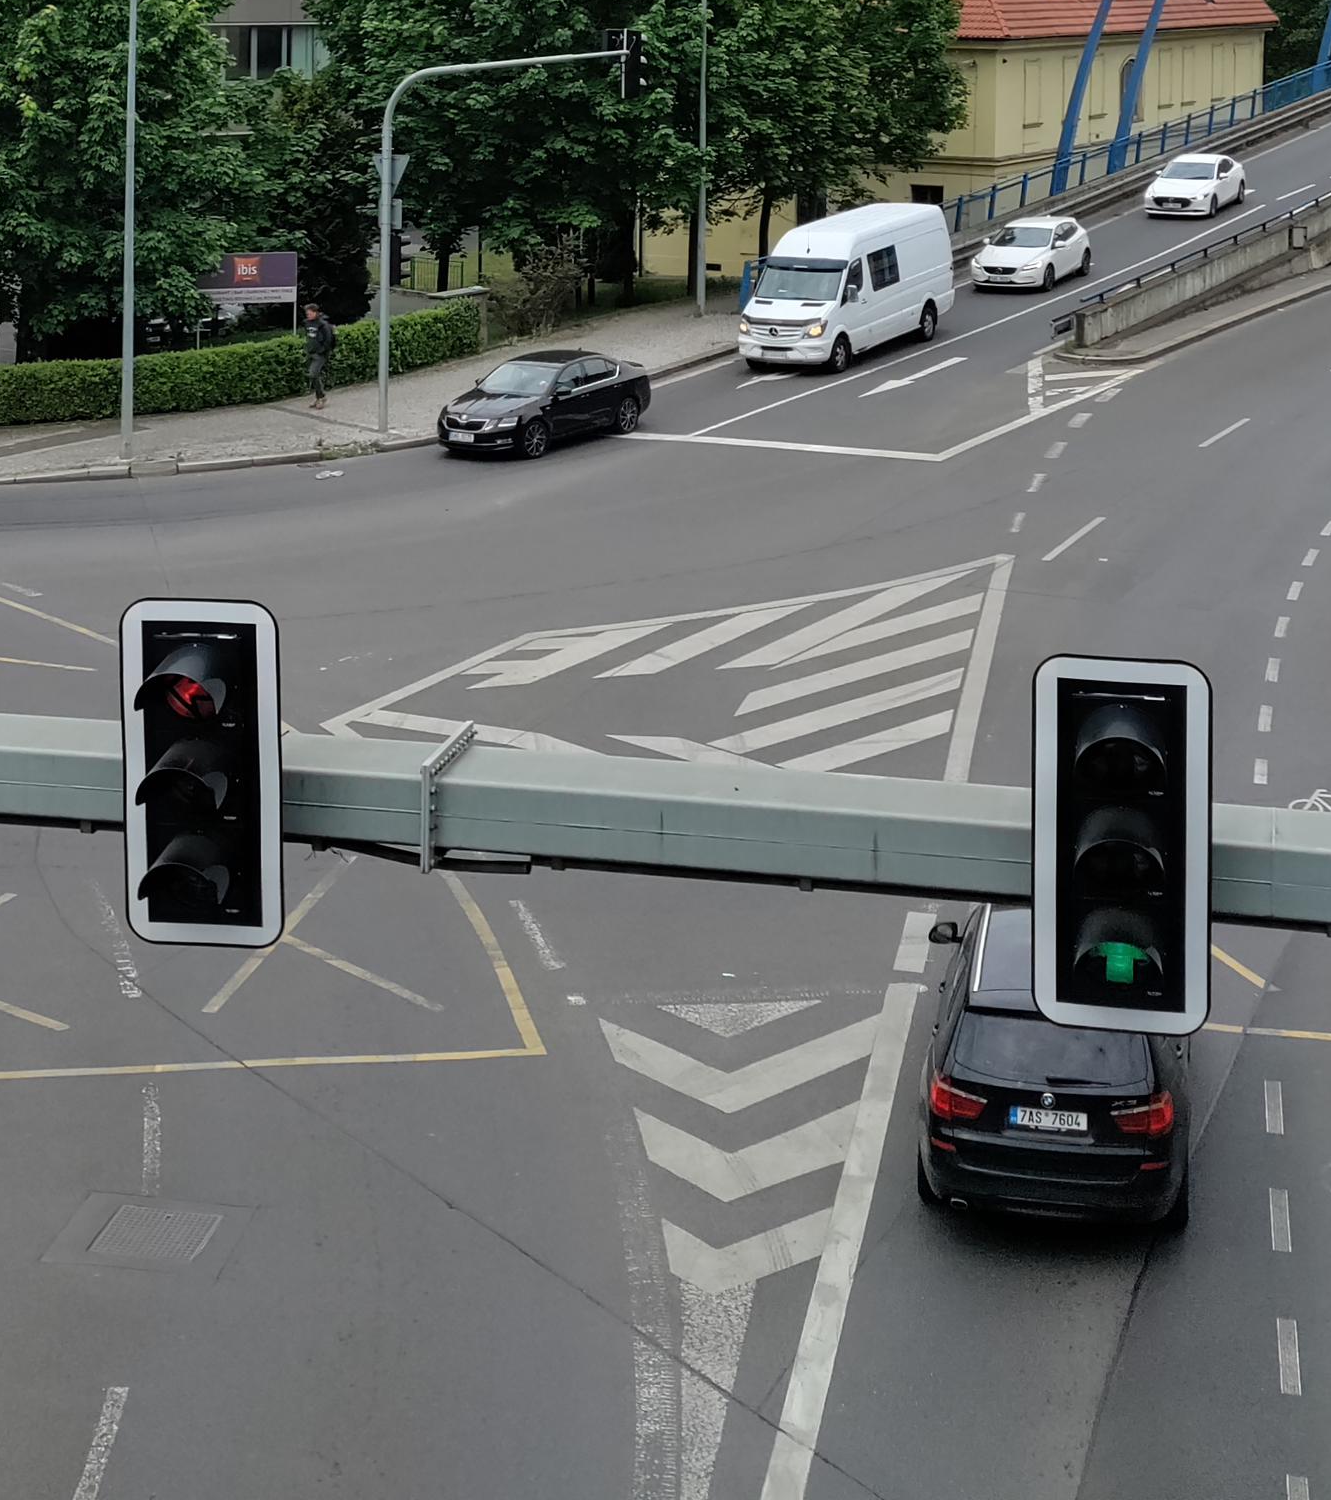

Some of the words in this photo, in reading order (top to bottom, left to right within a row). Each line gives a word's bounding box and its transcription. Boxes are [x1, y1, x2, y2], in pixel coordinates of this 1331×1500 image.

[237, 264, 257, 275] ibis
[1020, 1109, 1042, 1124] 7AS
[1051, 1112, 1081, 1127] 7604
